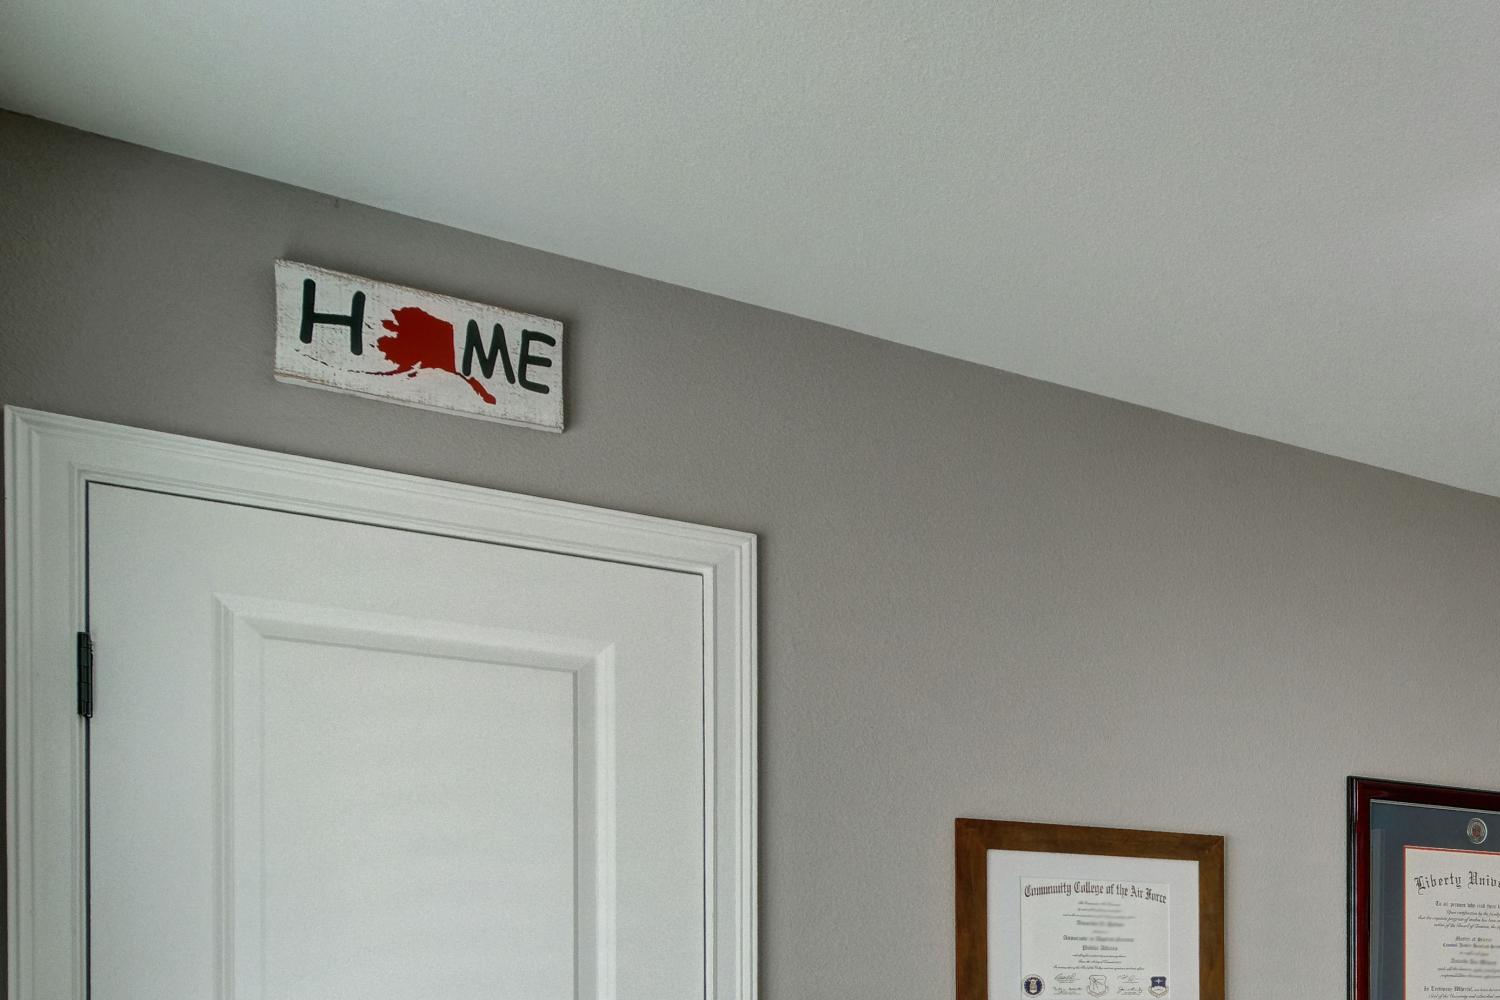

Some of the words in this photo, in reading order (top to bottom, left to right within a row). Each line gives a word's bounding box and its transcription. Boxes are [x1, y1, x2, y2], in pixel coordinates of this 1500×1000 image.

[300, 278, 556, 395] HME
[1024, 882, 1072, 898] Community
[1074, 881, 1104, 896] College
[1105, 883, 1114, 895] of
[1116, 884, 1128, 899] the
[1130, 885, 1143, 899] Air
[1145, 887, 1167, 904] Force
[1414, 872, 1462, 895] Liberty
